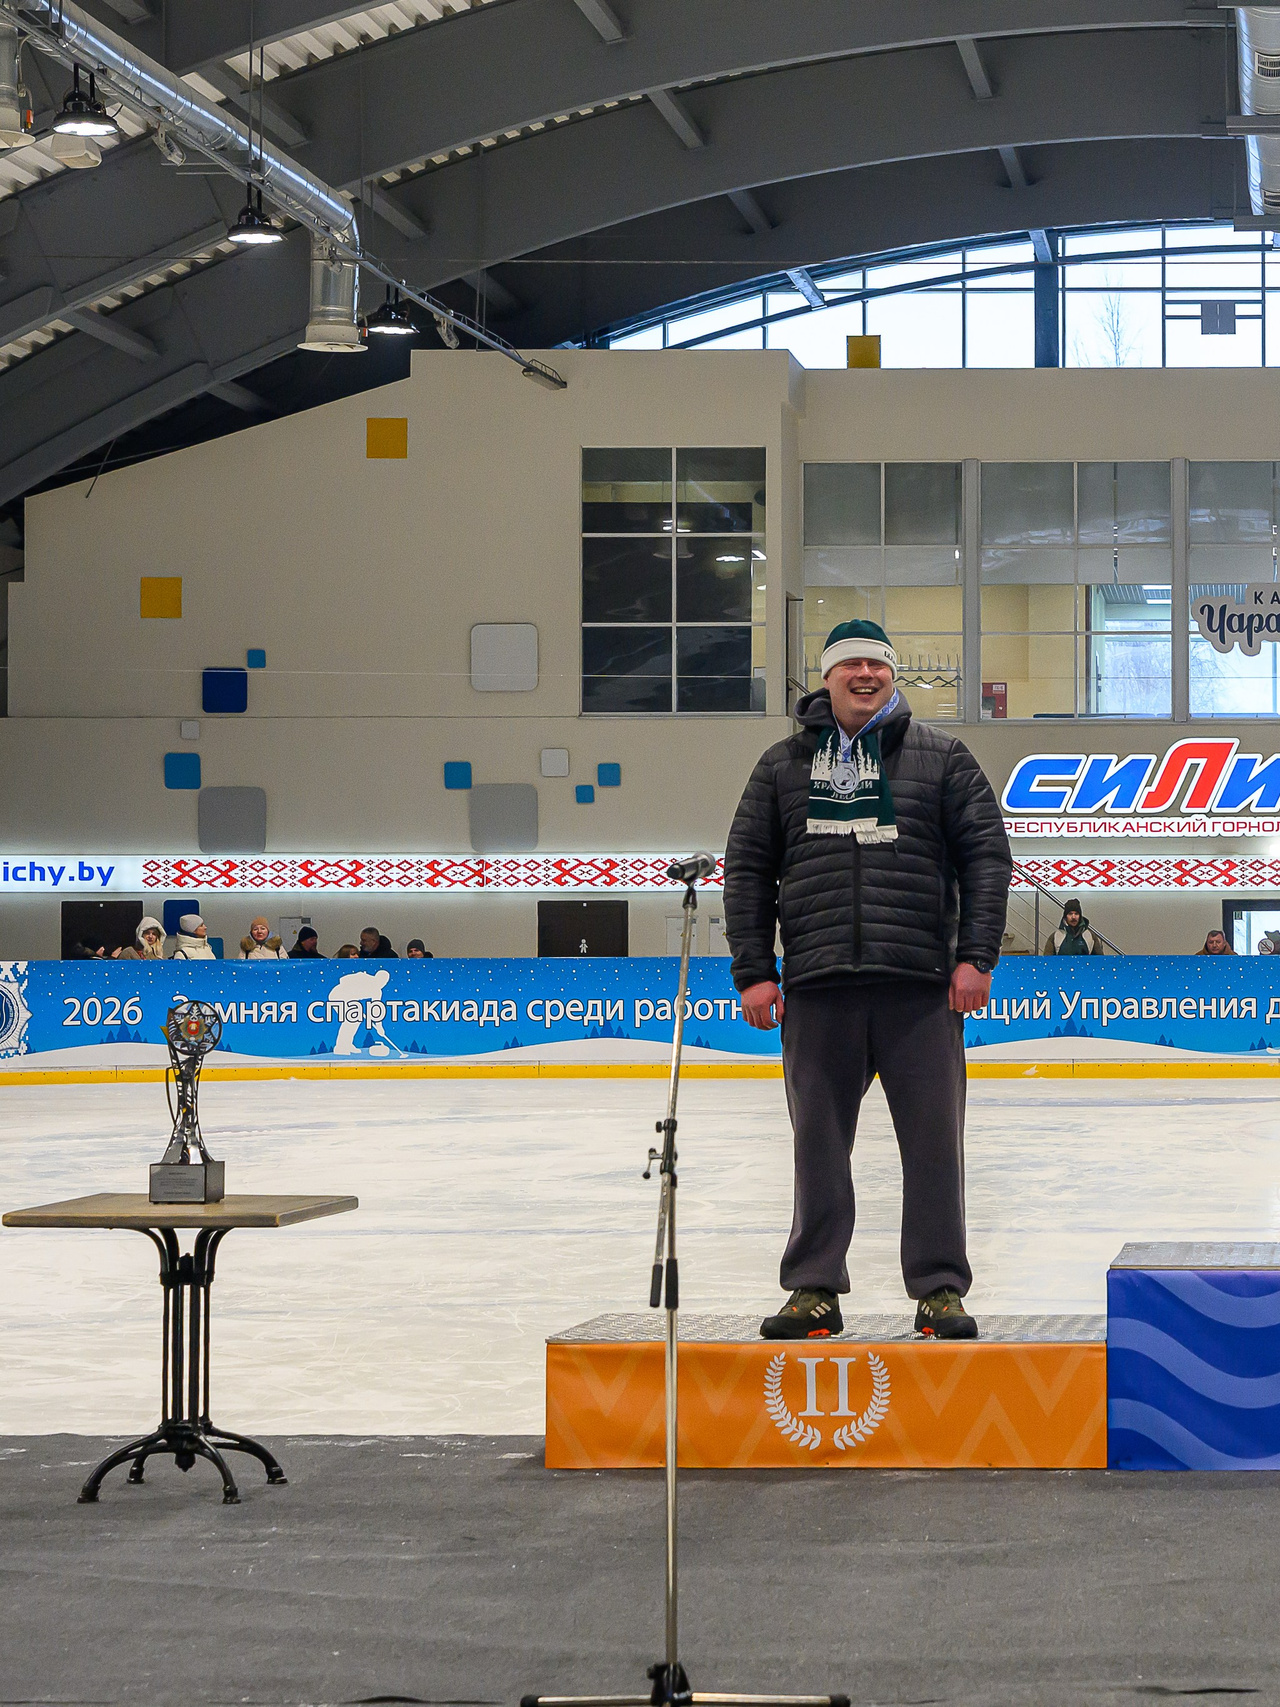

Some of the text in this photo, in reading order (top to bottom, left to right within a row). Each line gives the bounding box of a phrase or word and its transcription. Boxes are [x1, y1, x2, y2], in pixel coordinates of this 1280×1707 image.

[1004, 818, 1206, 834] РЕСПУБЛИКАНСКИЙ
[3, 861, 115, 887] ichy.by
[62, 996, 143, 1026] 2026
[172, 994, 298, 1024] мняя
[307, 1000, 518, 1030] спартакиада
[526, 999, 625, 1029] среди
[633, 990, 778, 1028] работн
[963, 990, 1051, 1026] аций
[1059, 990, 1257, 1027] Управления
[798, 1357, 857, 1417] II
